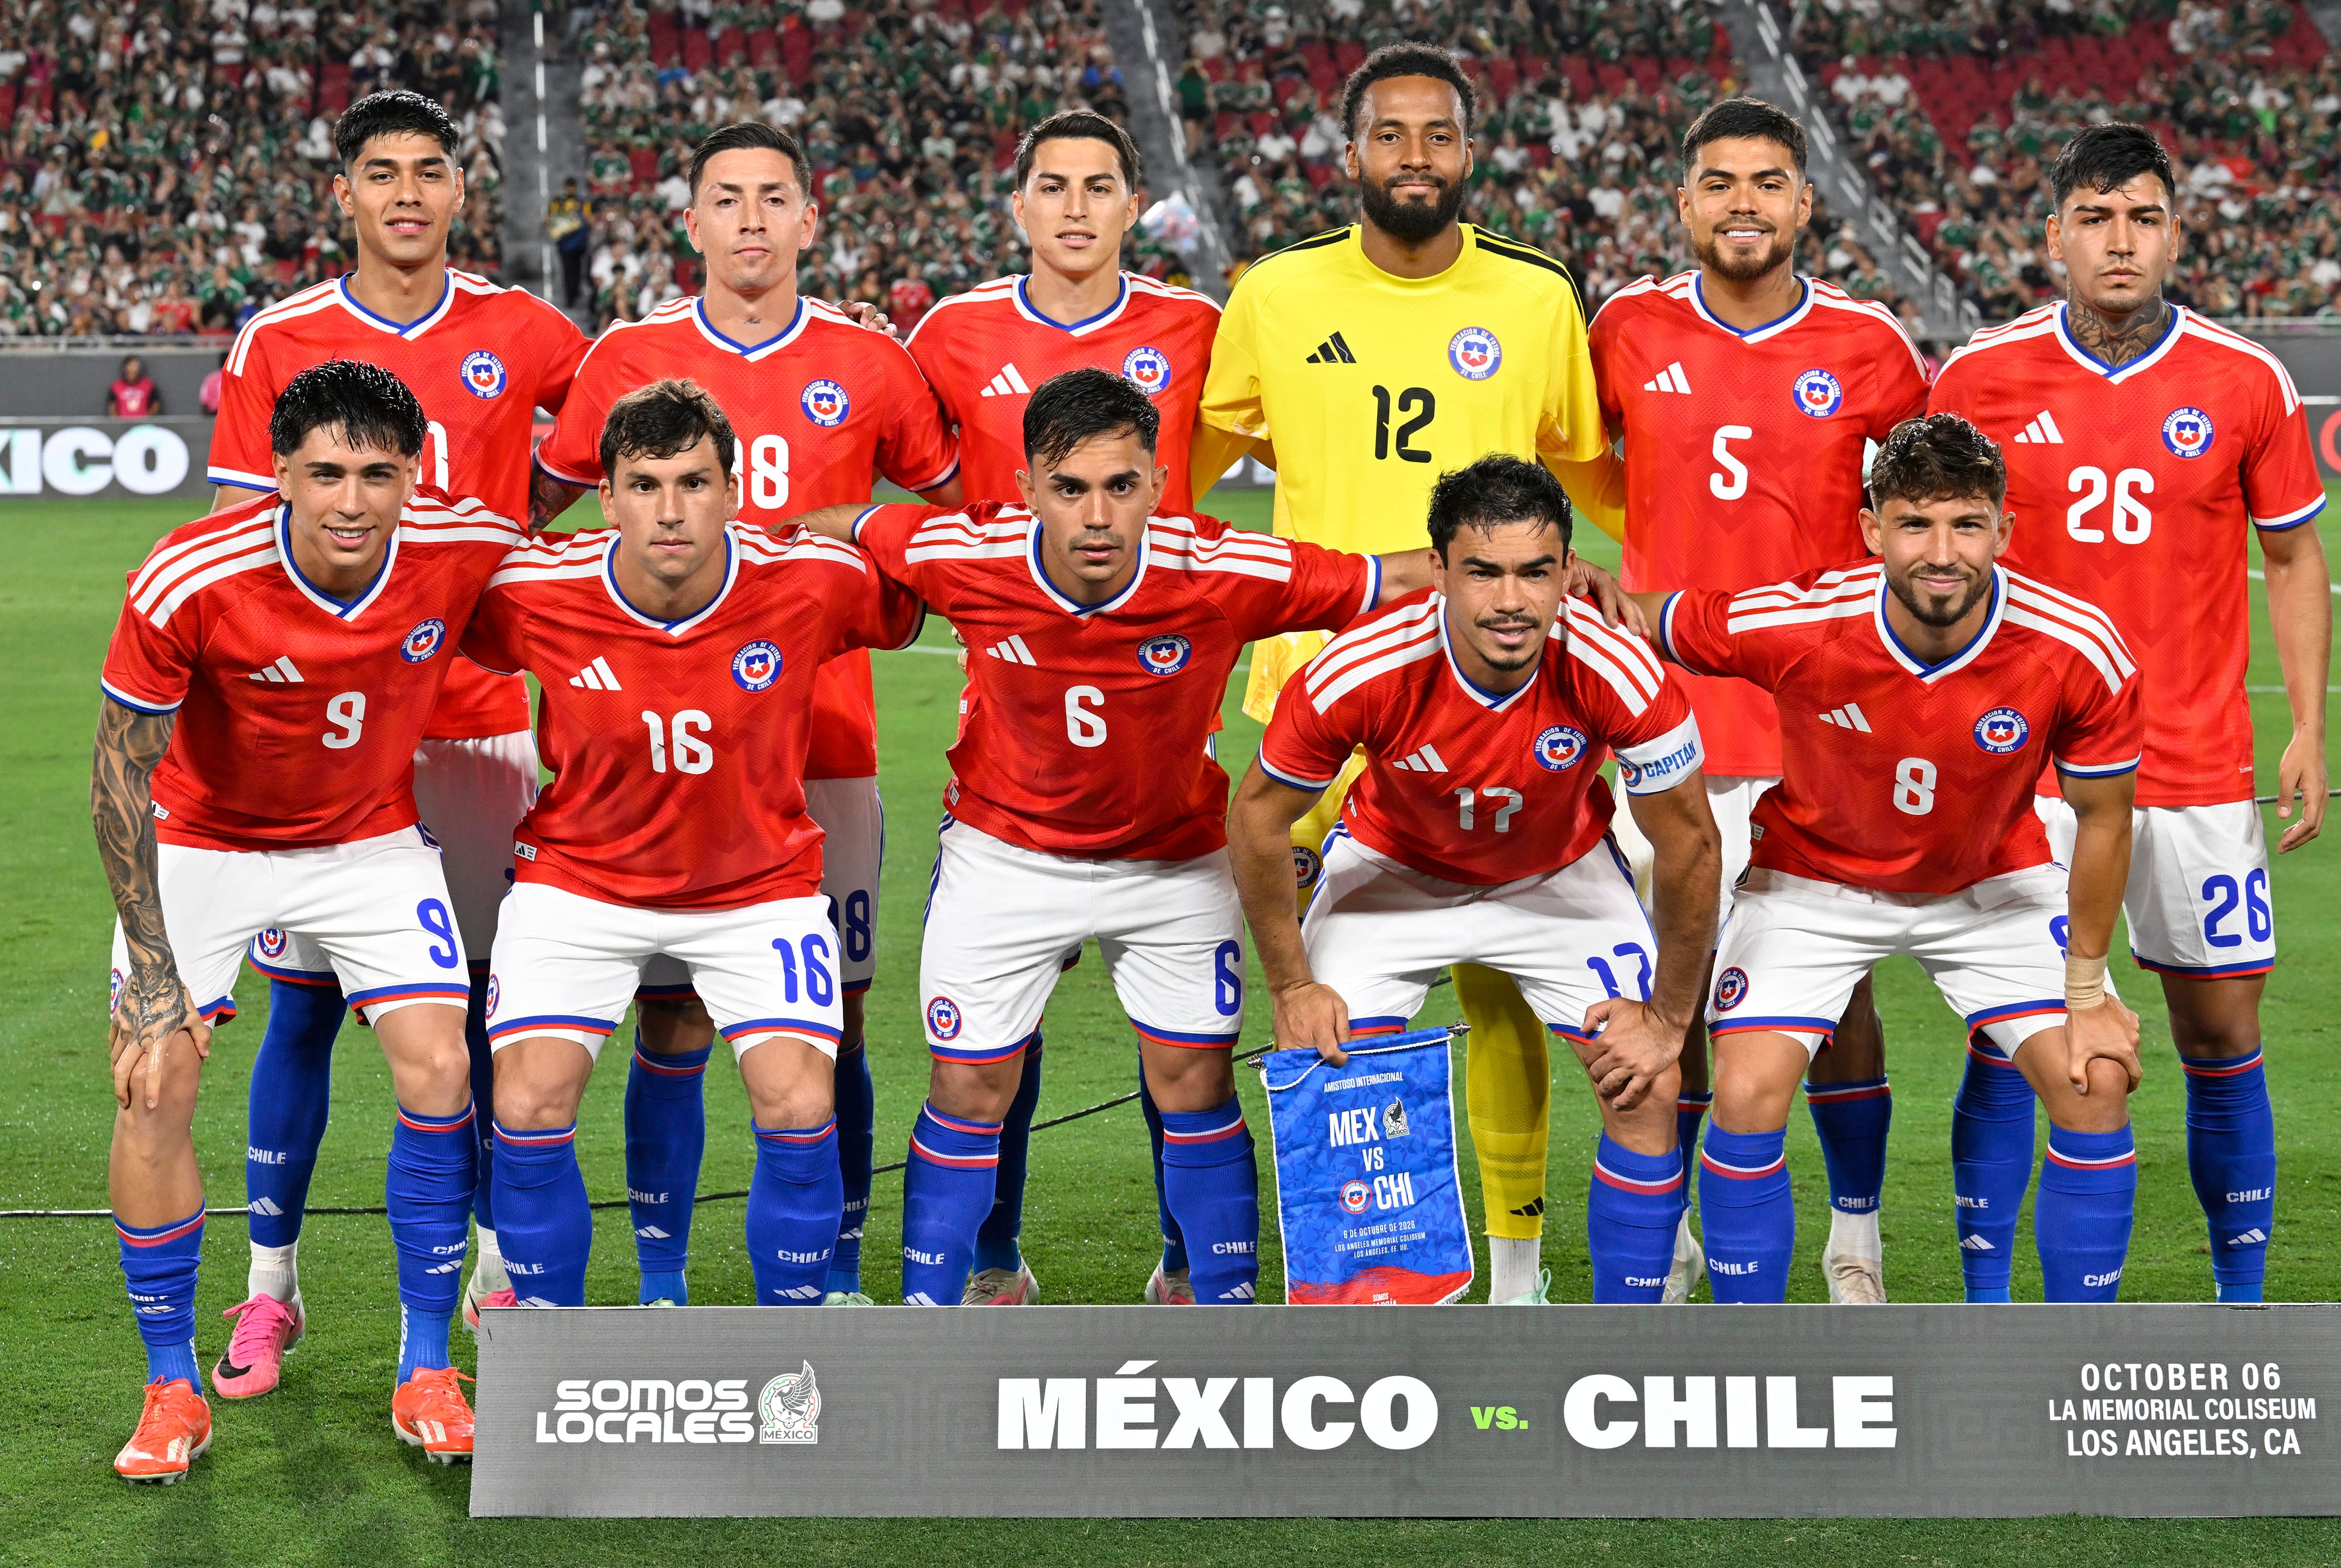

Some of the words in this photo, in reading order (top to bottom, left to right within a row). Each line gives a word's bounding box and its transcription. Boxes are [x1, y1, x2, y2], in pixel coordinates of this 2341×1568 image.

[1450, 328, 1477, 350] FEDERACION
[1488, 337, 1499, 357] FUTBOL
[491, 356, 504, 374] FUTBOL
[1156, 353, 1169, 371] FUTBOL
[486, 388, 499, 398] CHILE
[836, 386, 848, 405] FUTBOL
[1148, 384, 1162, 393] CHILE
[1829, 378, 1841, 397] FUTBOL
[1372, 385, 1435, 463] 12
[2200, 414, 2212, 434] FUTBOL
[416, 421, 449, 493] 1
[1710, 425, 1753, 500] 5
[2185, 449, 2201, 457] CHILE
[2067, 466, 2154, 545] 26
[421, 649, 435, 661] CHILE
[1176, 637, 1190, 650] FUTBOL
[733, 642, 757, 670] FEDERACION
[768, 644, 781, 662] FUTBOL
[1164, 664, 1180, 674] CHILE
[757, 679, 773, 690] CHILE
[322, 691, 366, 749] 9
[1065, 685, 1107, 747] 6
[1975, 709, 2003, 732] FEDERACION
[2014, 714, 2027, 733] FUTBOL
[641, 709, 713, 775] 16
[1535, 727, 1560, 752] FEDERACION
[1573, 731, 1587, 745] FUTBOL
[1561, 759, 1577, 769] CHILE
[1643, 740, 1696, 778] CAPITÁN
[1893, 757, 1937, 815] 8
[1454, 786, 1523, 833] 17
[2201, 868, 2272, 948] 26
[416, 898, 459, 969] 9
[771, 933, 833, 1007] 16
[1215, 940, 1241, 1016] 6
[1587, 942, 1653, 1002] 17
[1324, 1078, 1355, 1093] AMISTOSO
[1355, 1071, 1403, 1087] INTERNACIONAL
[1329, 1106, 1379, 1147] MEX
[248, 1146, 286, 1165] CHILE
[1362, 1146, 1384, 1171] VS
[629, 1187, 668, 1204] CHILE
[1373, 1172, 1415, 1210] CHI
[1838, 1196, 1876, 1209] CHILE
[2226, 1187, 2271, 1203] CHILE
[843, 1196, 868, 1212] HILE
[1343, 1230, 1348, 1239] 6
[1350, 1229, 1358, 1238] DE
[1359, 1224, 1388, 1236] OCTUBRE
[1389, 1223, 1397, 1232] DE
[1399, 1220, 1415, 1230] 2026
[1212, 1241, 1255, 1254] CHILE
[1335, 1244, 1345, 1252] LOS
[1347, 1240, 1369, 1250] ANGELES
[1371, 1236, 1399, 1246] MEMORIAL
[1400, 1232, 1426, 1242] COLISEUM
[778, 1247, 830, 1264] CHILE
[904, 1247, 945, 1266] CHILE
[1709, 1258, 1759, 1275] CHILE
[2083, 1266, 2123, 1287] CHIL
[1373, 1292, 1389, 1302] SOMOS
[2081, 1363, 2229, 1391] OCTOBER
[2242, 1362, 2281, 1391] 06
[554, 1380, 749, 1411] SOMOS
[997, 1360, 1439, 1450] MÉXICO
[1563, 1374, 1898, 1450] CHILE
[2048, 1399, 2078, 1421] LA
[2082, 1398, 2200, 1421] MEMORIAL
[2204, 1397, 2317, 1421] COLISEUM
[536, 1409, 755, 1444] LOCALES
[764, 1428, 813, 1440] MÉXICO
[2067, 1429, 2119, 1457] LOS
[2125, 1428, 2257, 1459] ANGELES,
[2264, 1428, 2302, 1456] CA
